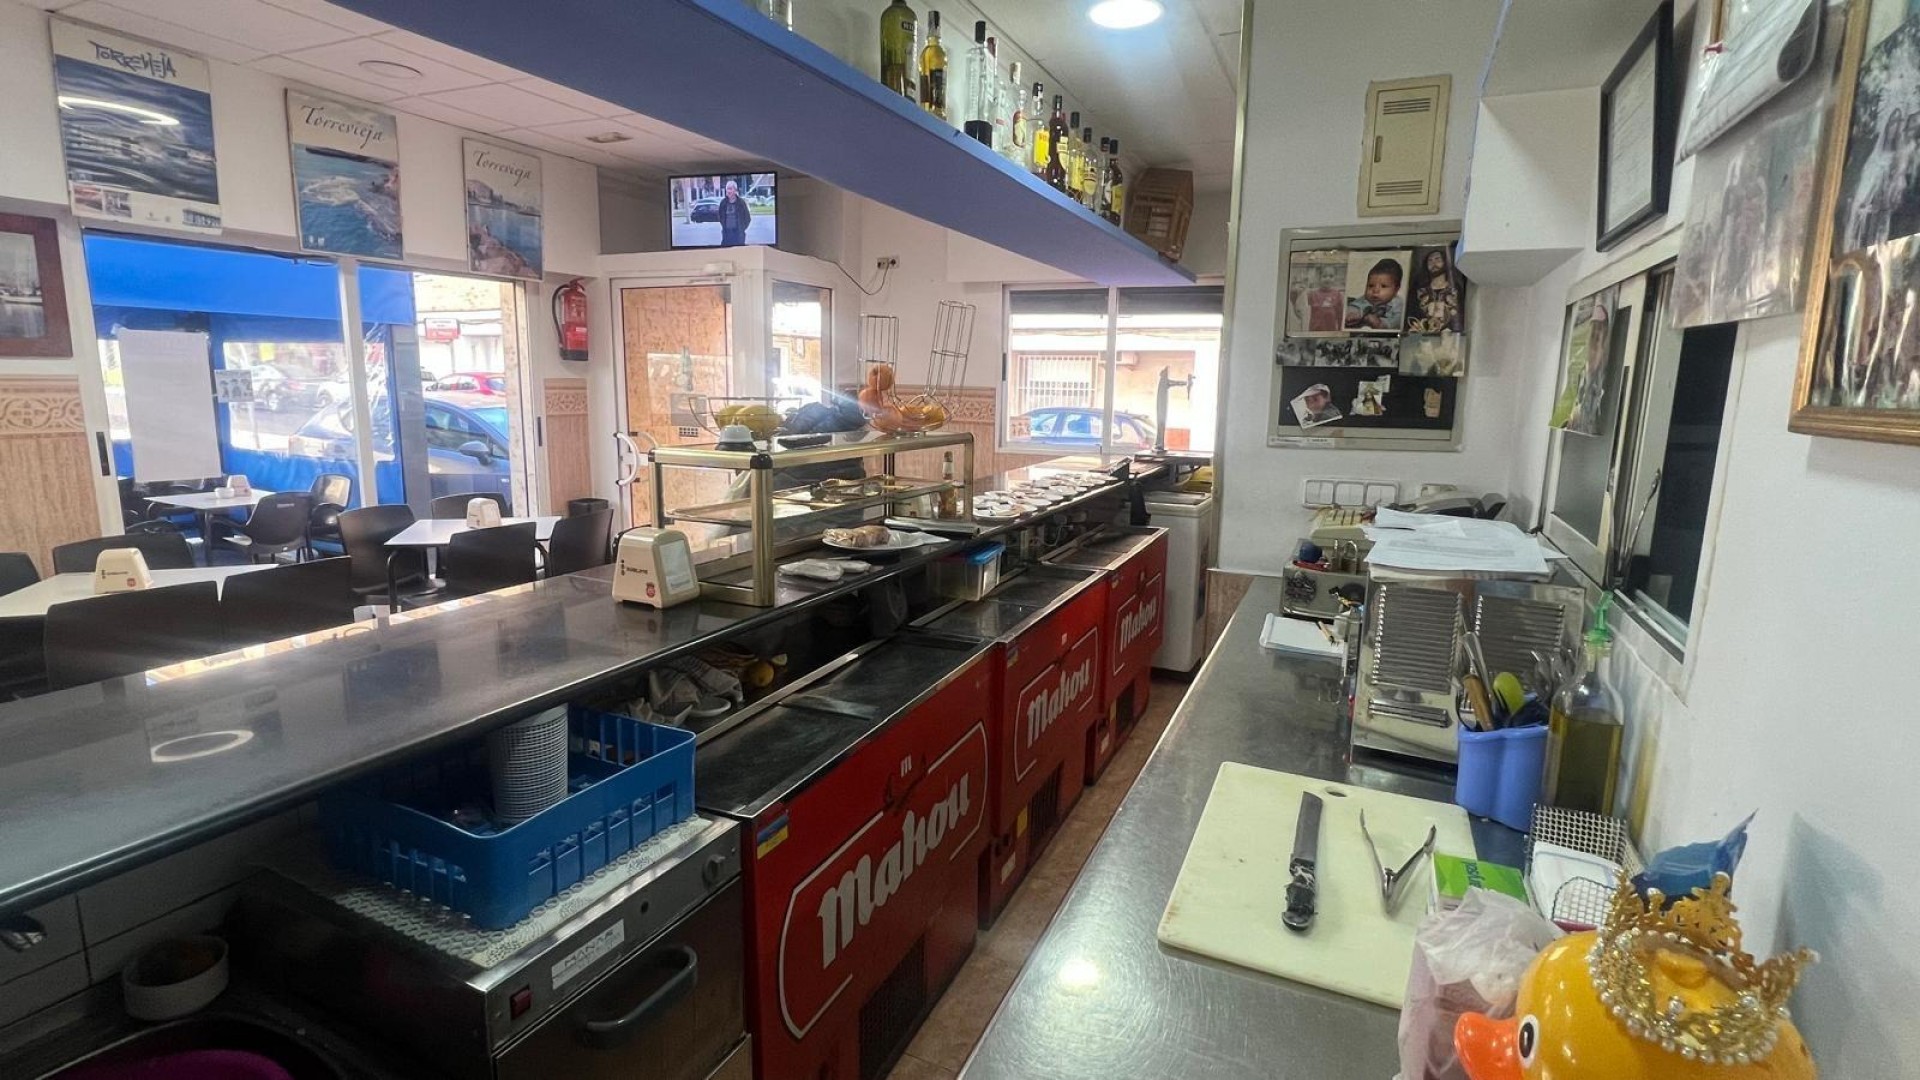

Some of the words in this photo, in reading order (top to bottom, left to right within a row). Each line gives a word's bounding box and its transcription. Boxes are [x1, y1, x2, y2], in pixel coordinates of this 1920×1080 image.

[87, 39, 177, 78] TORREVIEJA
[301, 105, 384, 150] Torrevieja
[473, 150, 533, 188] Torrevieja
[1120, 596, 1157, 654] Mahou
[1027, 659, 1089, 749] Mahou
[817, 772, 970, 970] Mahou
